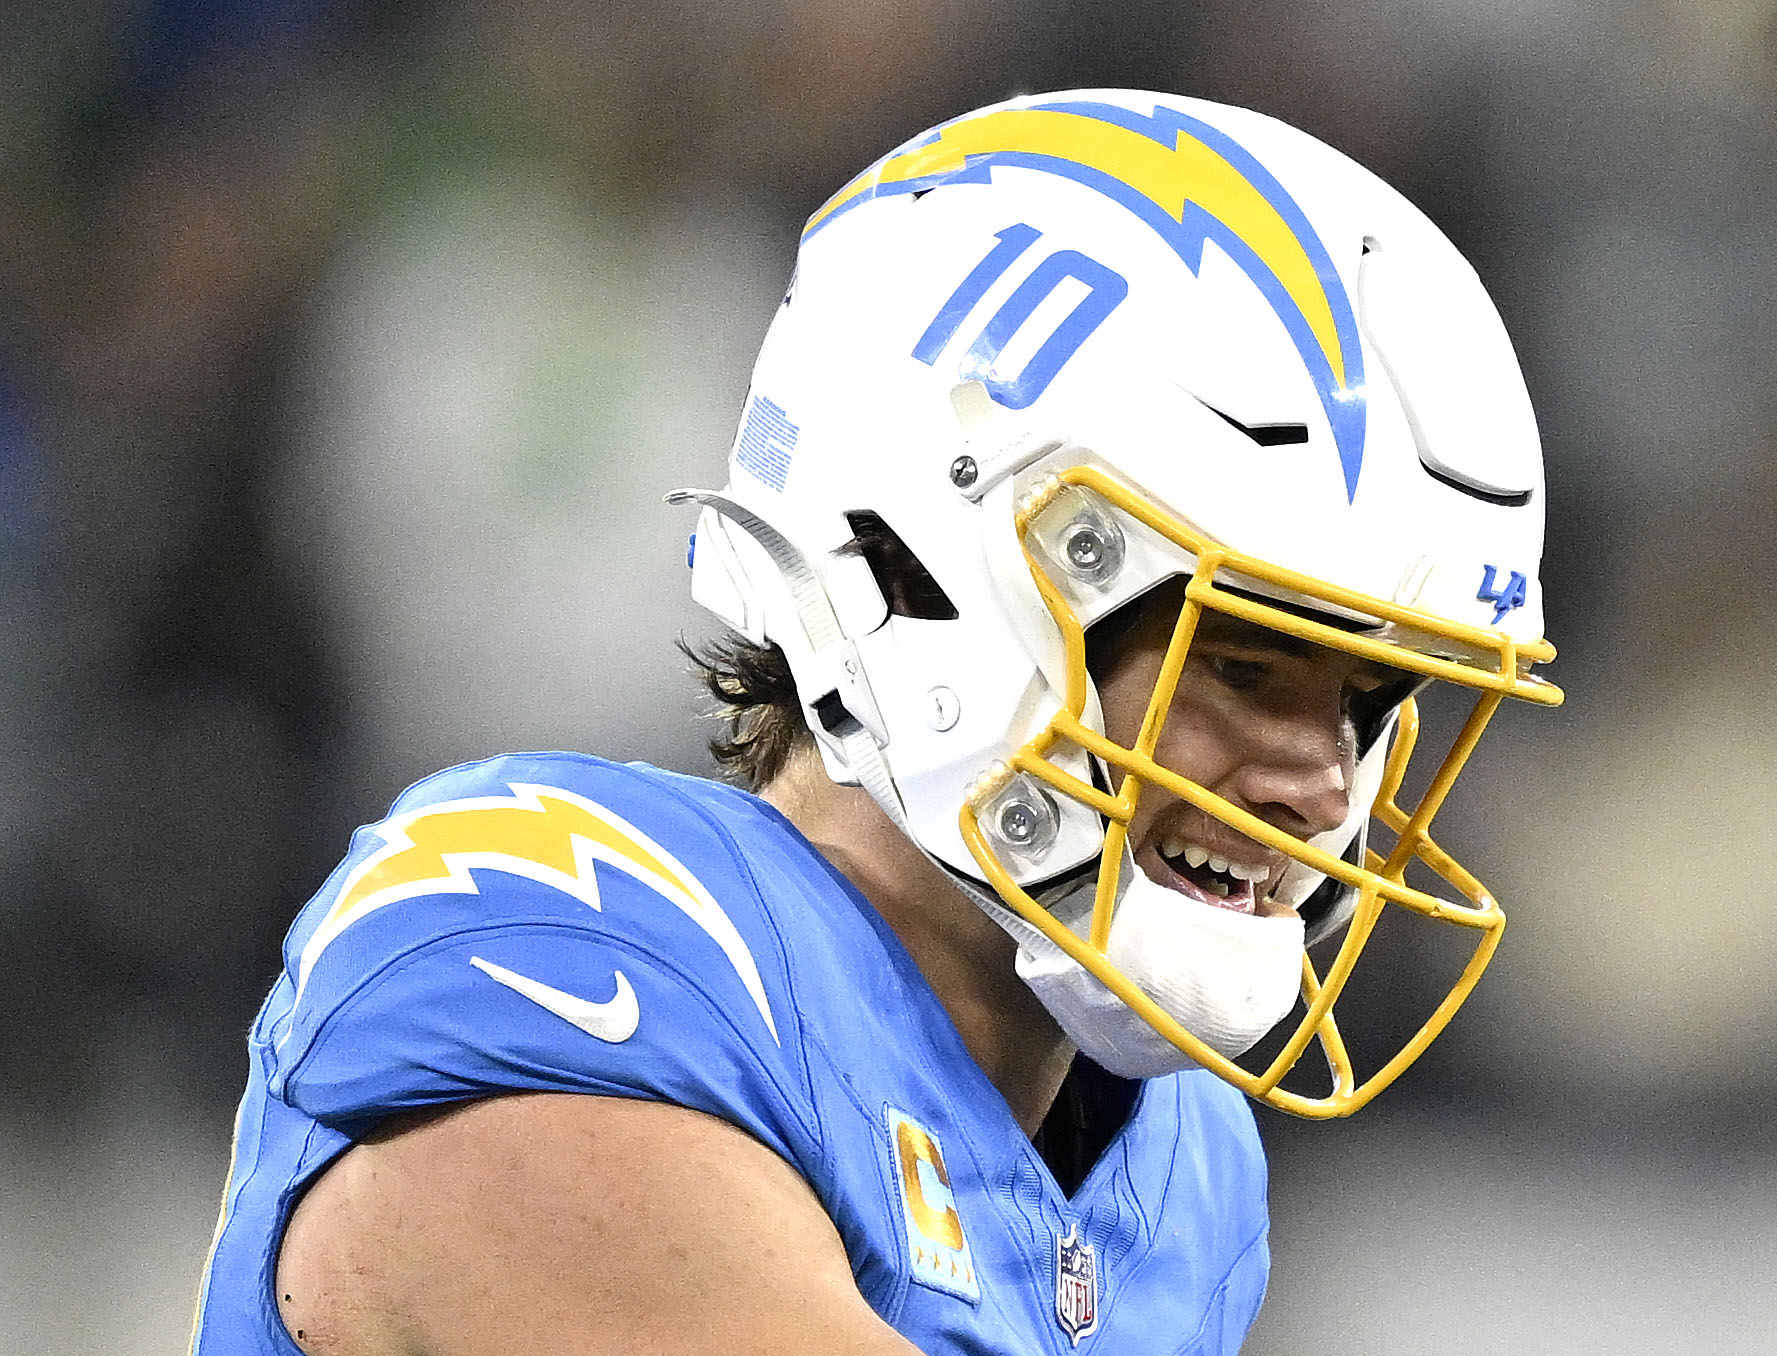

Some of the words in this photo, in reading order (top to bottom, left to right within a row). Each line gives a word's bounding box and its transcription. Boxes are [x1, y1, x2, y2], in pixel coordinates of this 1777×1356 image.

[911, 222, 1129, 410] 10
[897, 1120, 964, 1251] C
[1063, 1278, 1093, 1322] NFL
